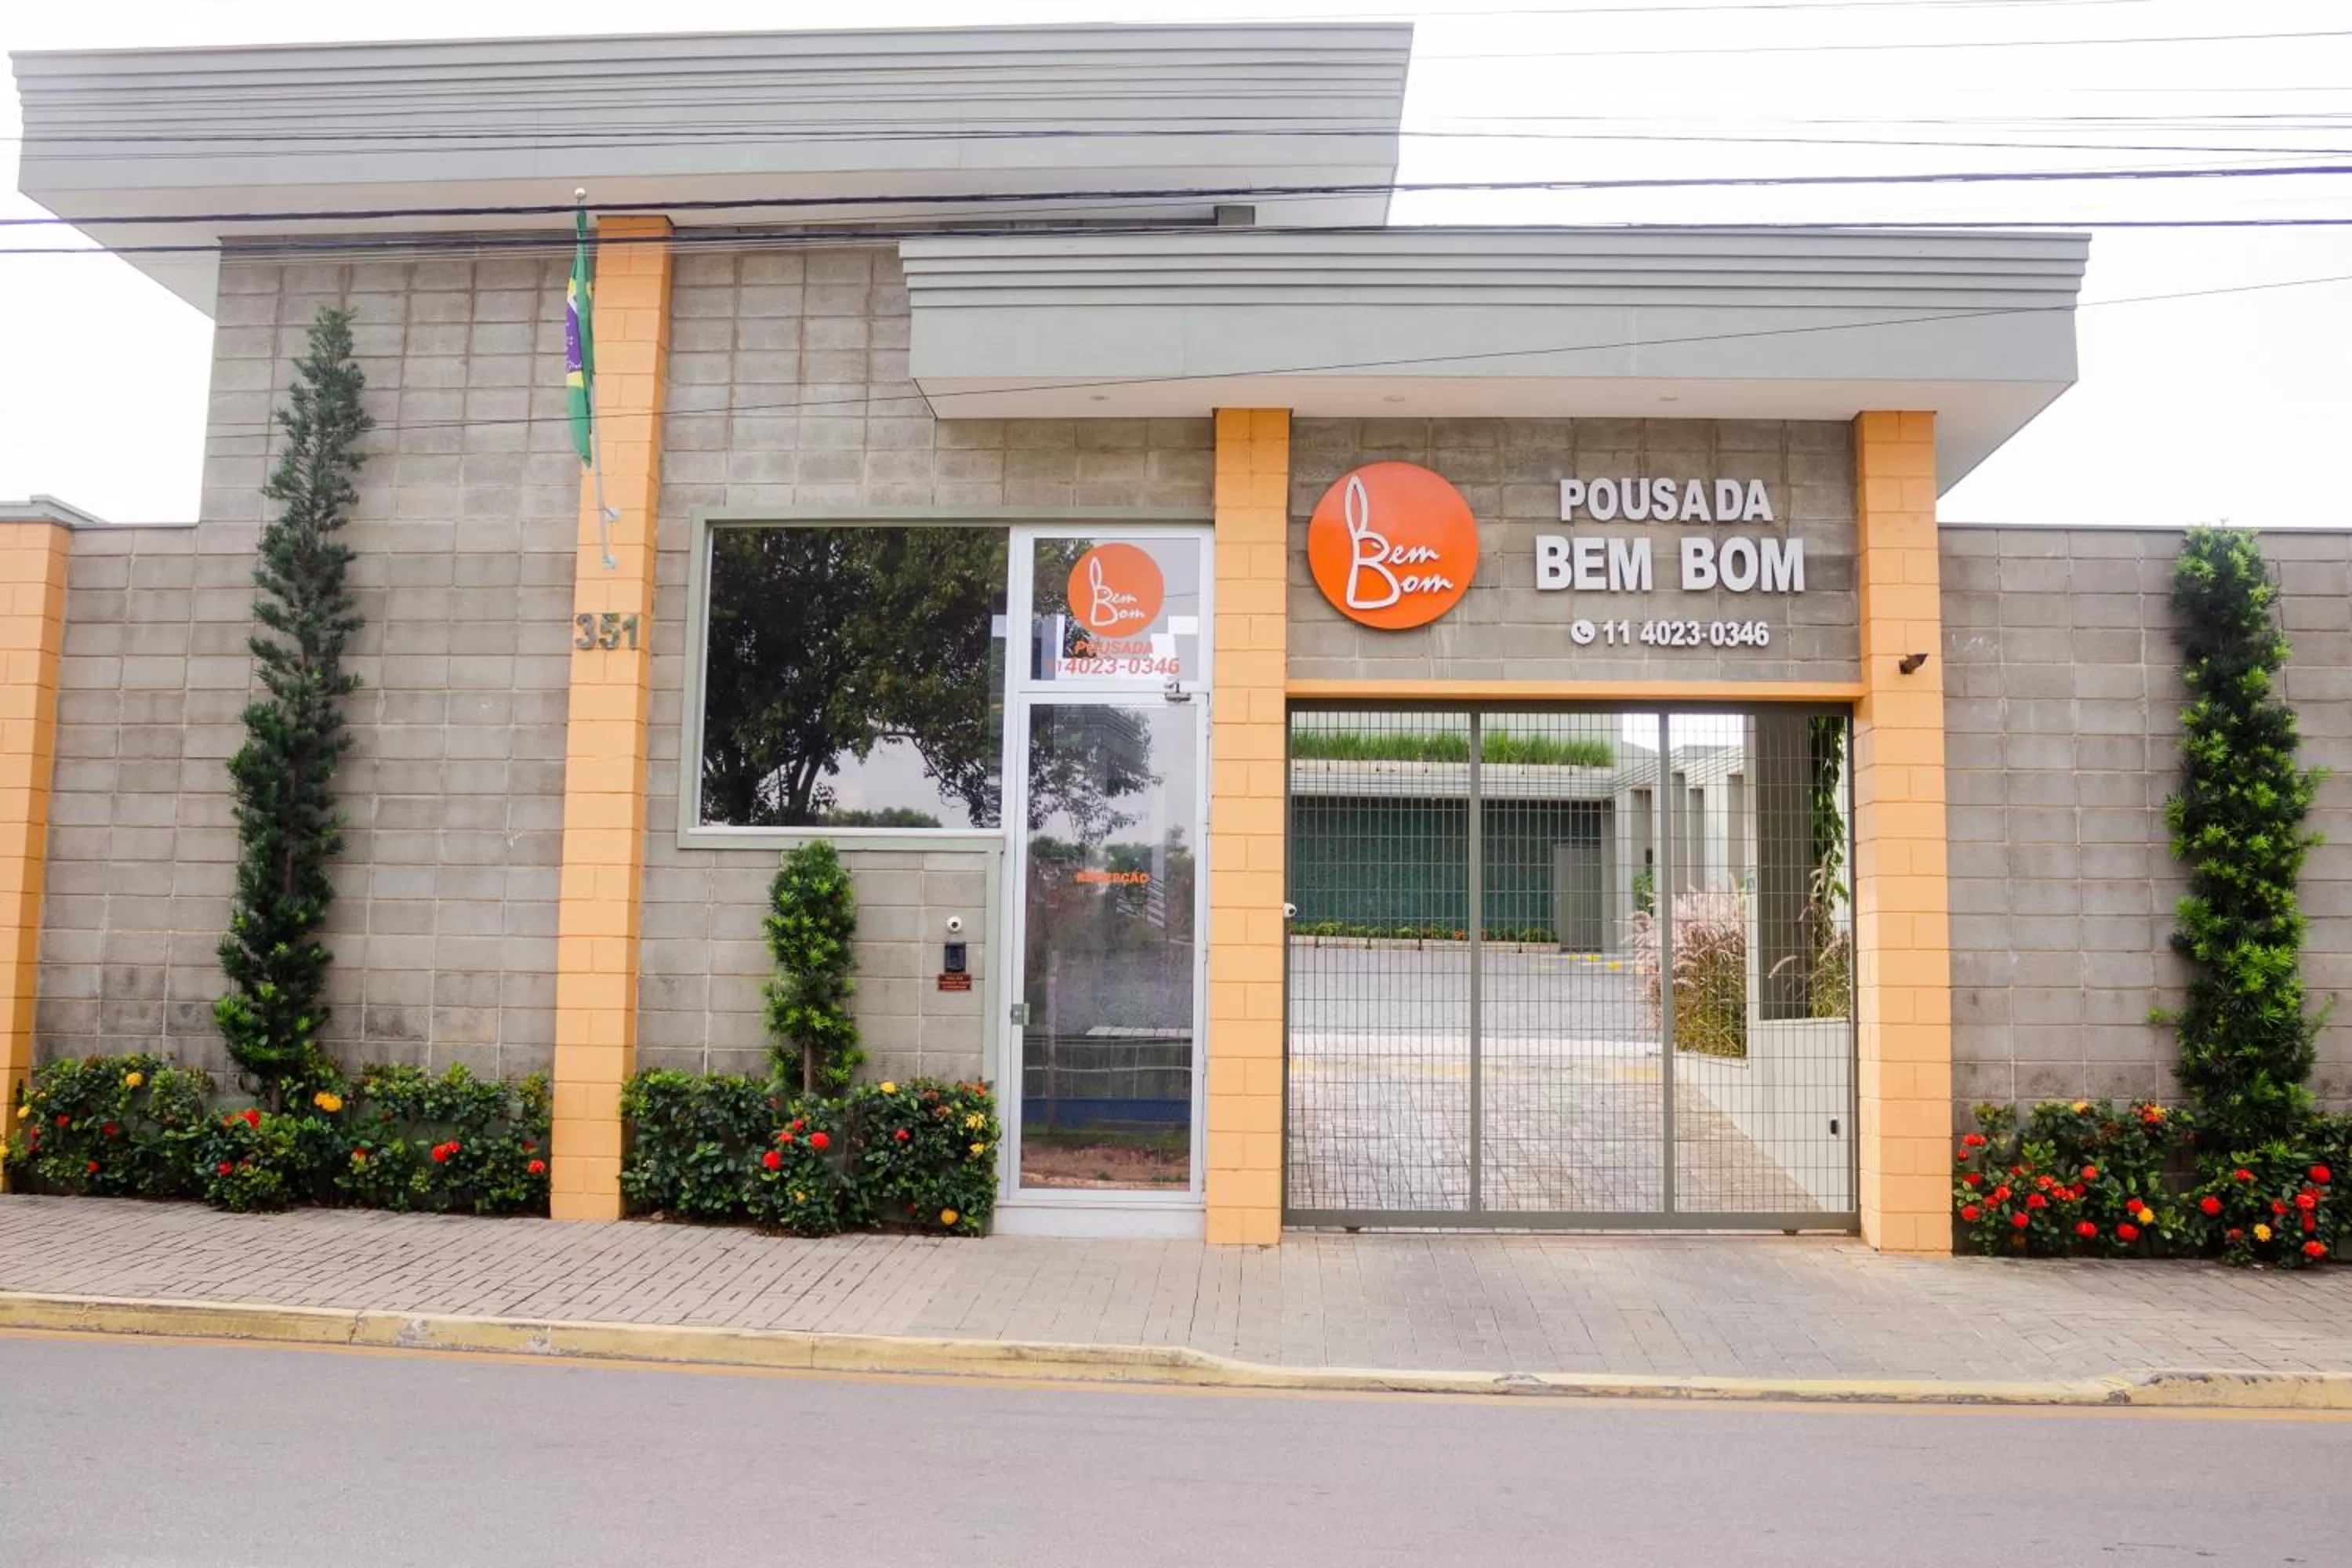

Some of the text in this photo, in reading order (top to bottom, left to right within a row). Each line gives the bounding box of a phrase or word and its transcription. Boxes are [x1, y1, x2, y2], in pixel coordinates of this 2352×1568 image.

[1560, 477, 1774, 521] POUSADA
[1536, 535, 1806, 592] BEM BOM
[575, 613, 638, 650] 351
[1603, 620, 1769, 647] 11 4023-0346
[1064, 657, 1180, 675] 4023-0346
